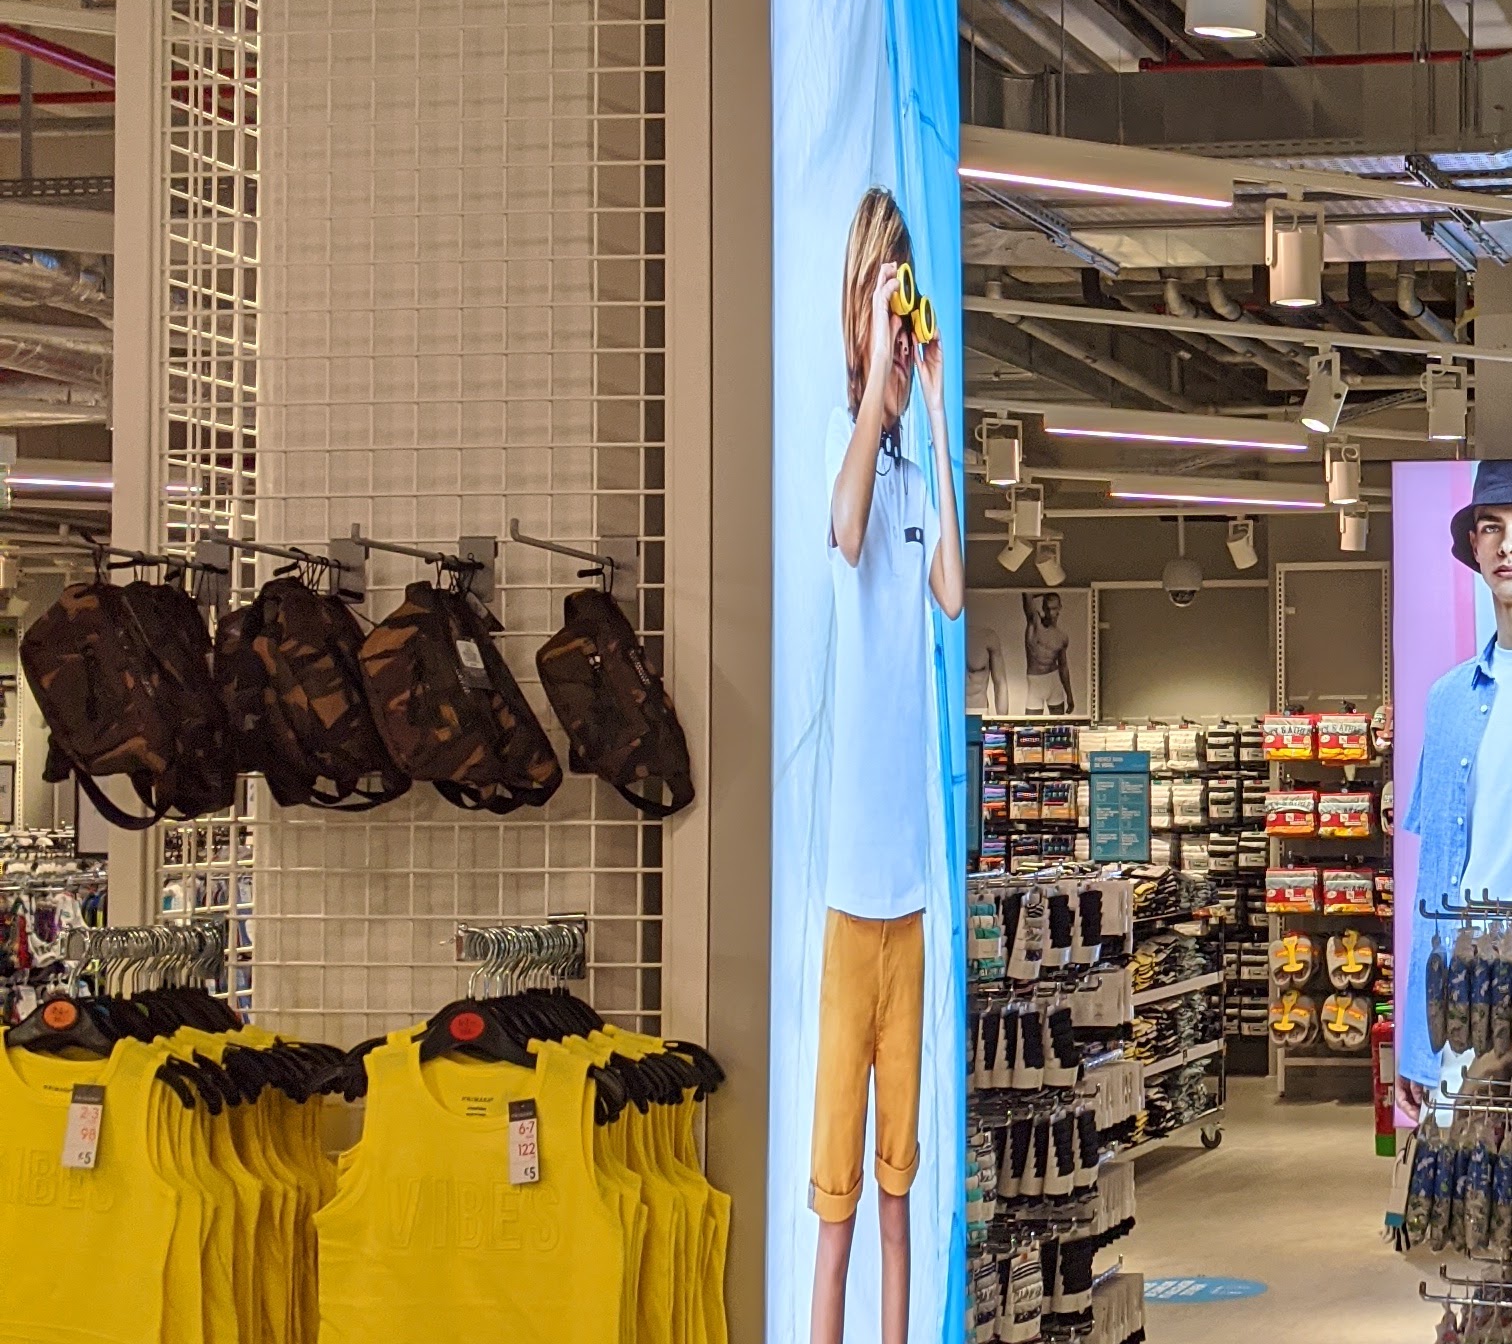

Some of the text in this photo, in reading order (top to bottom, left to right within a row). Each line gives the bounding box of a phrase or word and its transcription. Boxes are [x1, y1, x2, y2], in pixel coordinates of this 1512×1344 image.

[518, 1121, 535, 1135] 6-7
[518, 1143, 536, 1156] 122
[387, 1175, 561, 1252] VIBES
